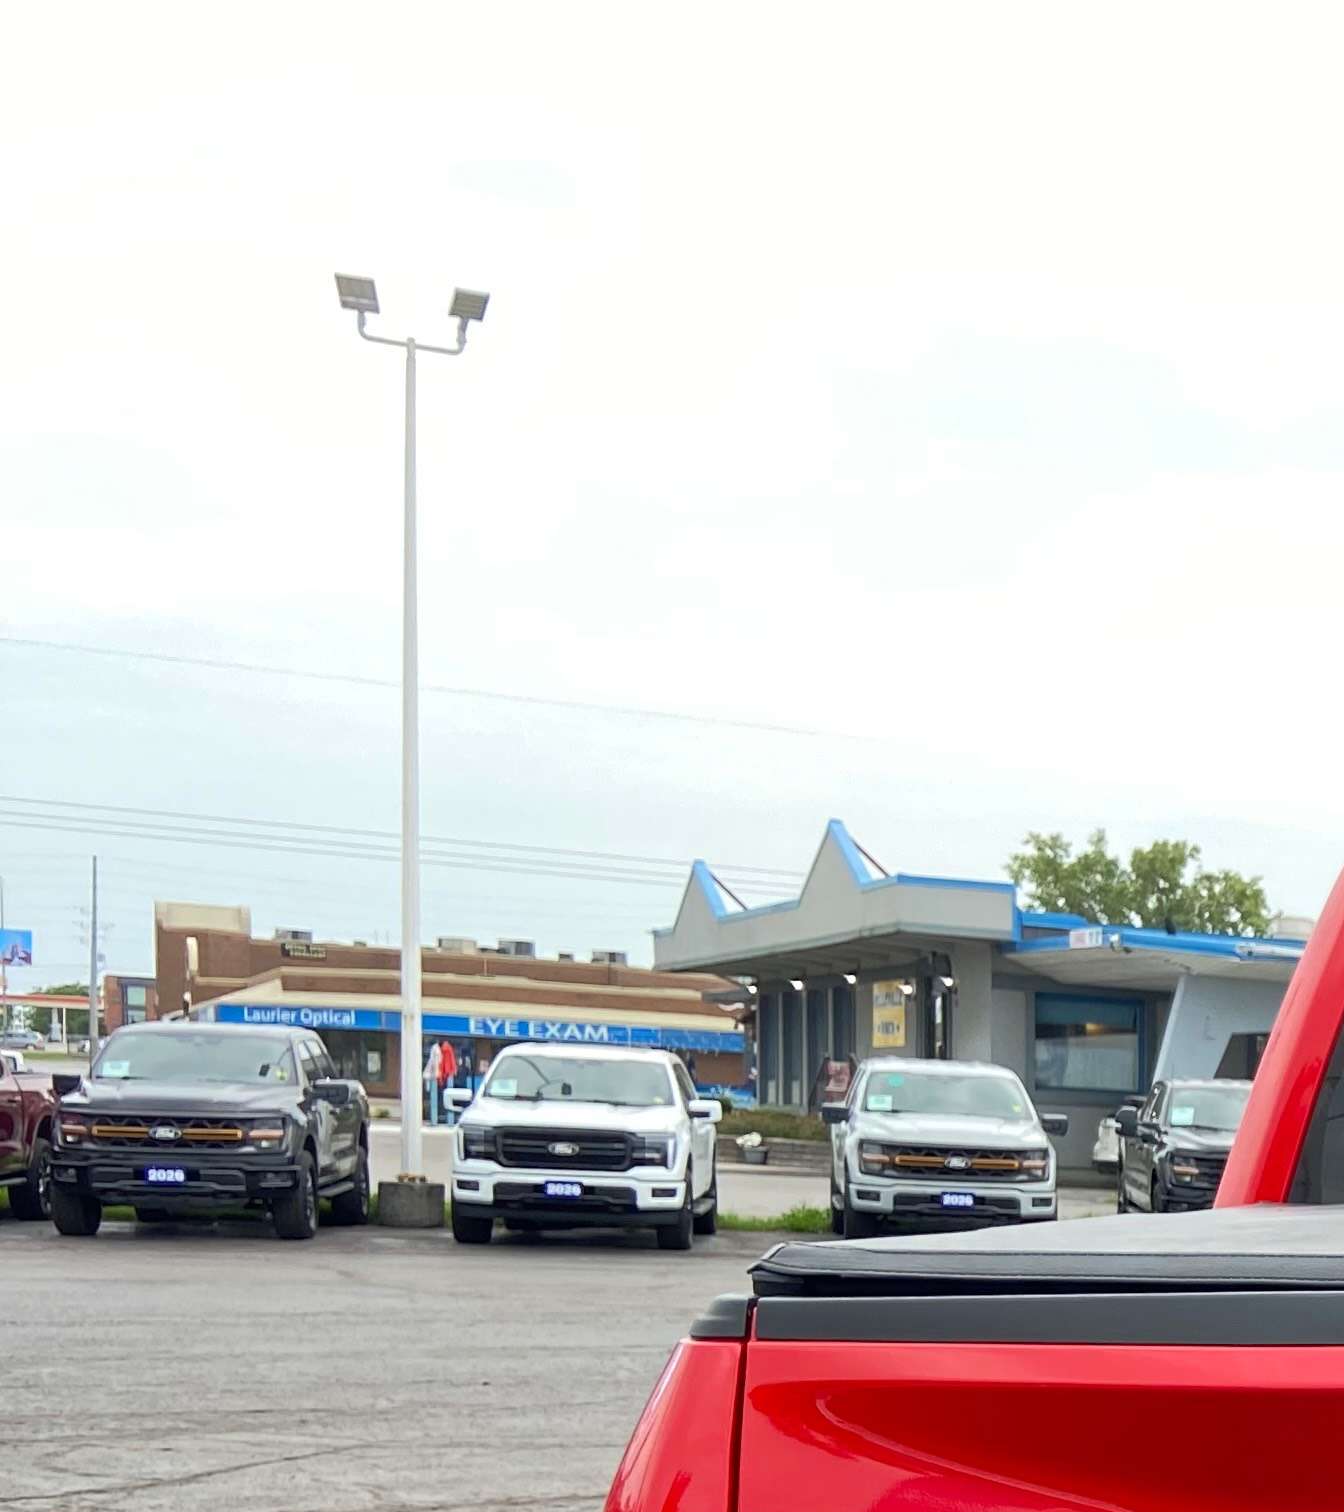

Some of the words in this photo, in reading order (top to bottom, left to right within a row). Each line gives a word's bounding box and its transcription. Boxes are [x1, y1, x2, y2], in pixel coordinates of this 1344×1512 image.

[243, 1006, 296, 1022] Laurier
[300, 1008, 356, 1027] Optical
[469, 1016, 519, 1036] EYE
[528, 1020, 608, 1041] EXAM
